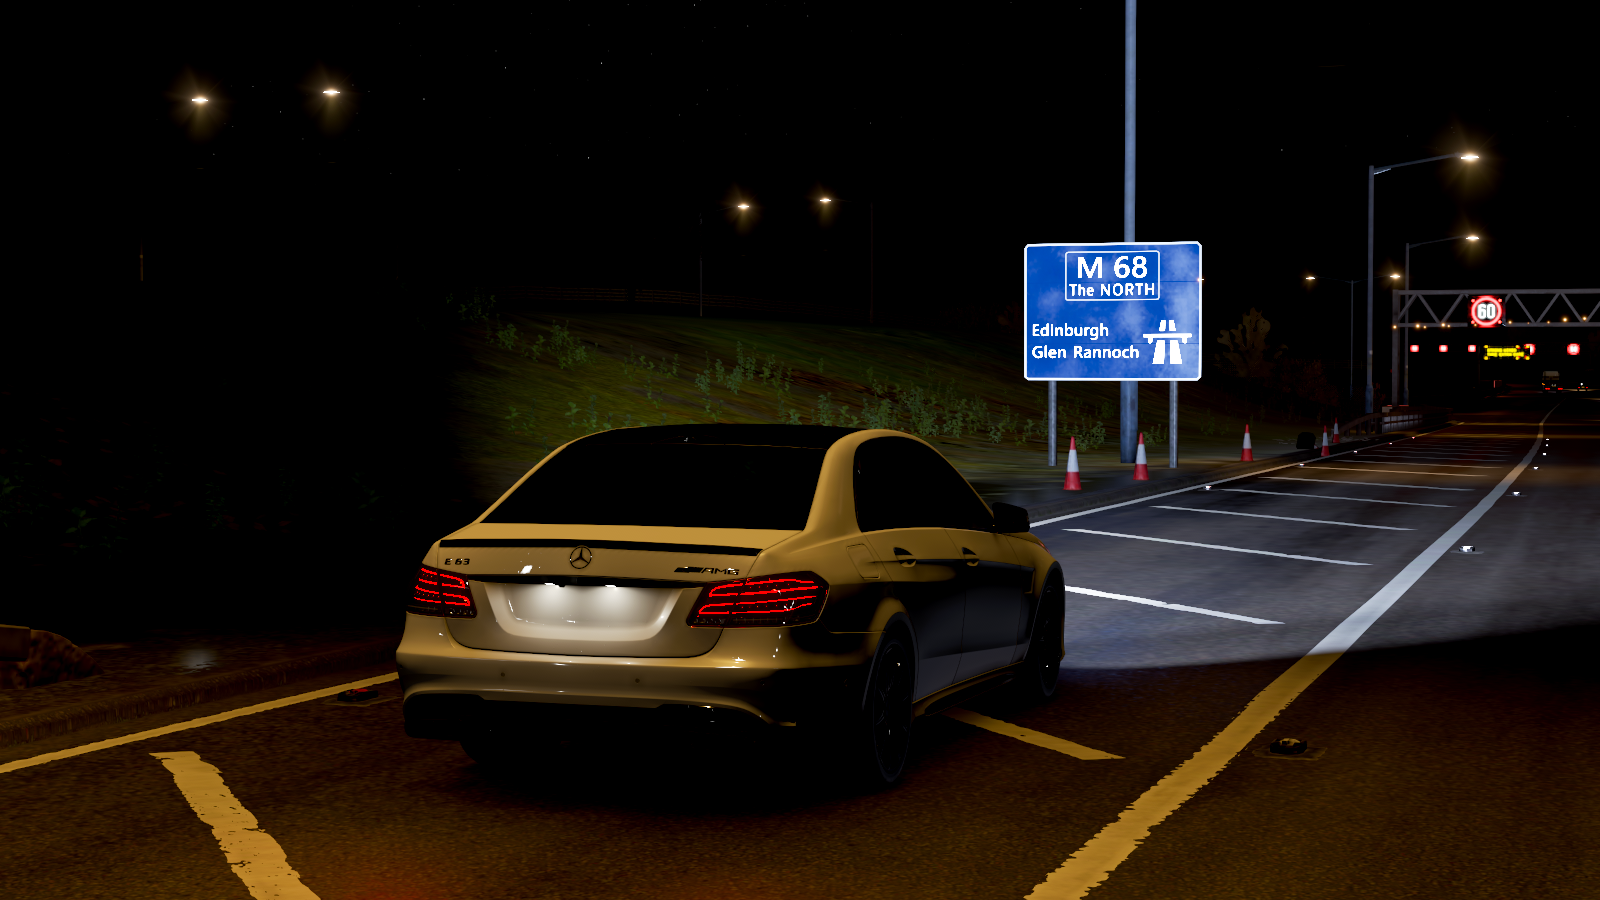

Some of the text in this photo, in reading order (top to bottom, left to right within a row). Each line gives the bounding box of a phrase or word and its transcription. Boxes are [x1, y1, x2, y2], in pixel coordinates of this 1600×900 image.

[1077, 255, 1148, 279] M 68
[1069, 282, 1155, 297] The NORTH
[1477, 303, 1496, 320] 60
[1032, 322, 1109, 341] Edinburgh
[1031, 344, 1140, 359] Glen Rannoch
[444, 558, 471, 566] E 63
[701, 567, 740, 576] AMG
